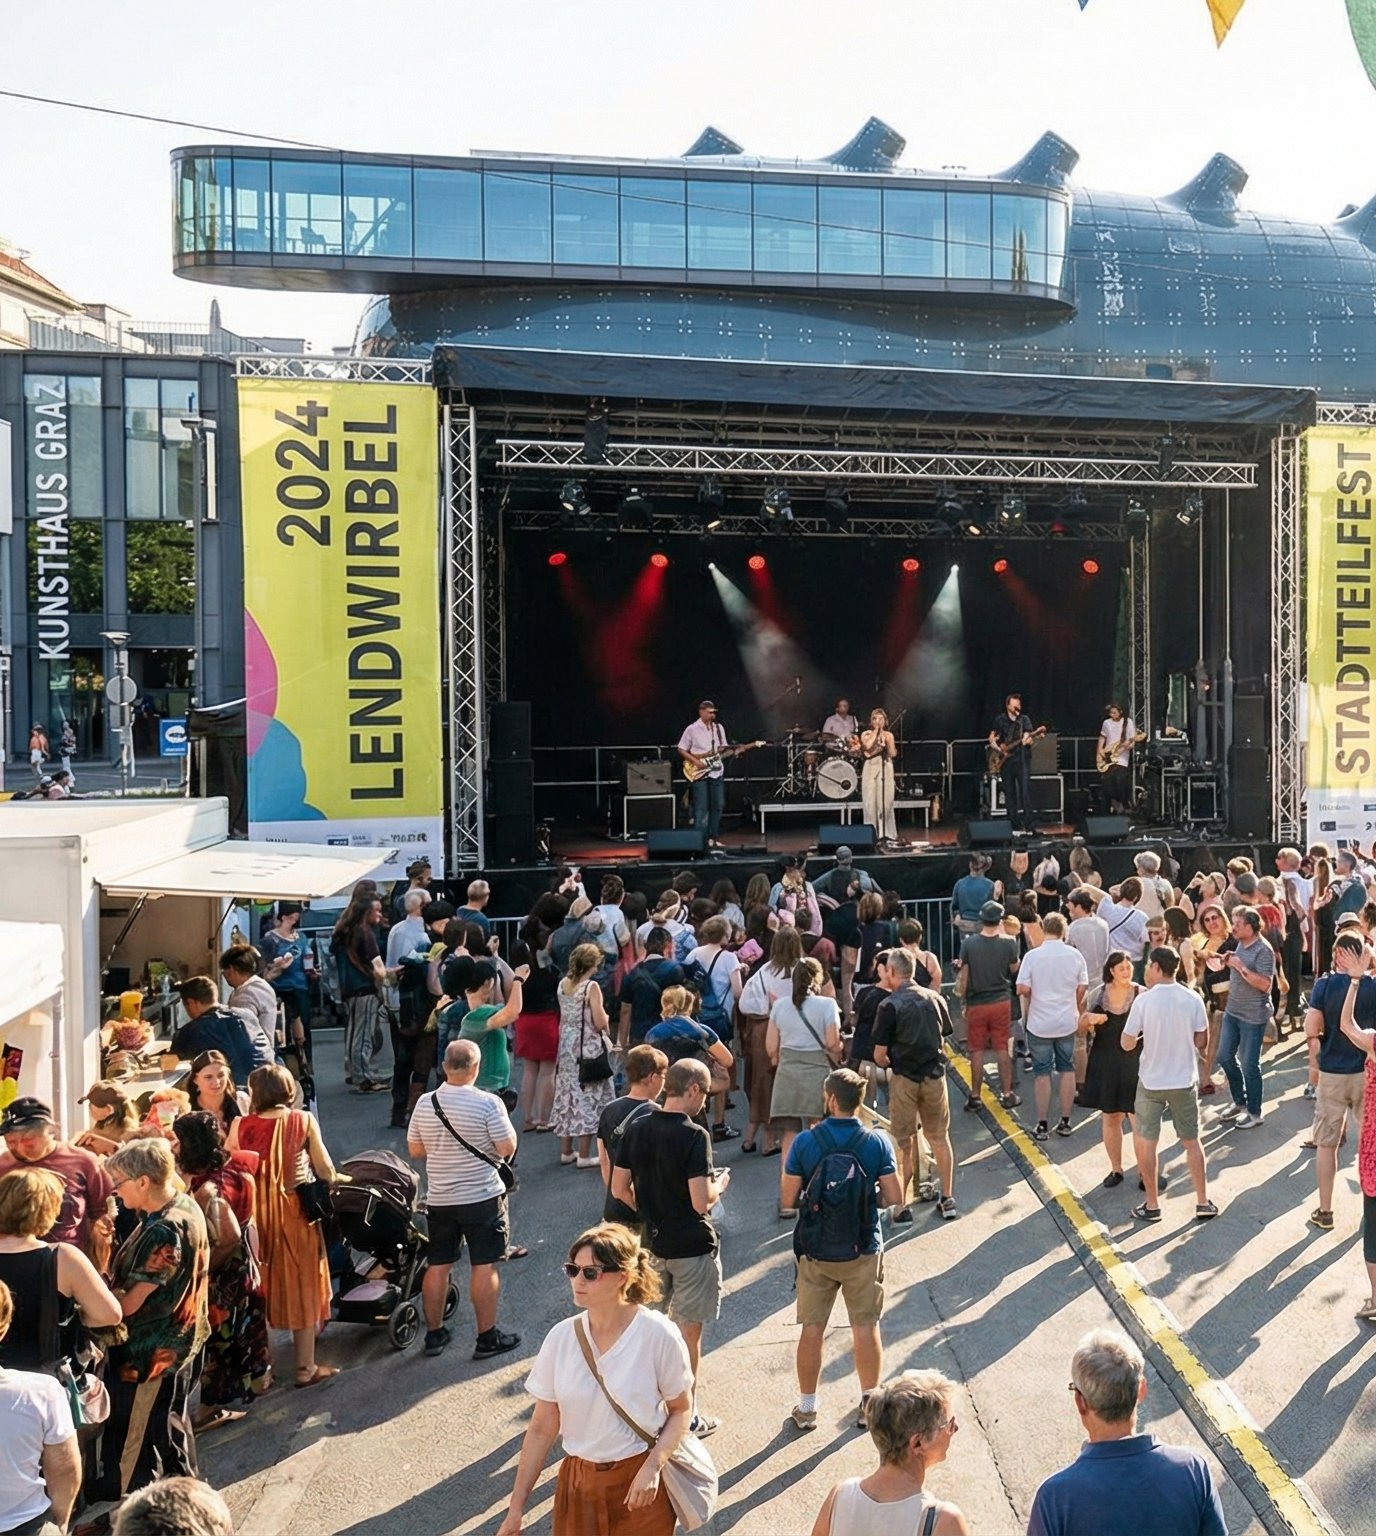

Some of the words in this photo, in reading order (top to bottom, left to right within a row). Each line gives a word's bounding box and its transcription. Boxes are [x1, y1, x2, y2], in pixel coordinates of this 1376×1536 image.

[35, 383, 67, 460] GRAZ
[275, 401, 330, 546] 2024
[37, 474, 70, 660] KUNSTHAUS
[343, 404, 403, 800] LENDWIRBEL
[1336, 443, 1372, 774] STADTTEILFEST
